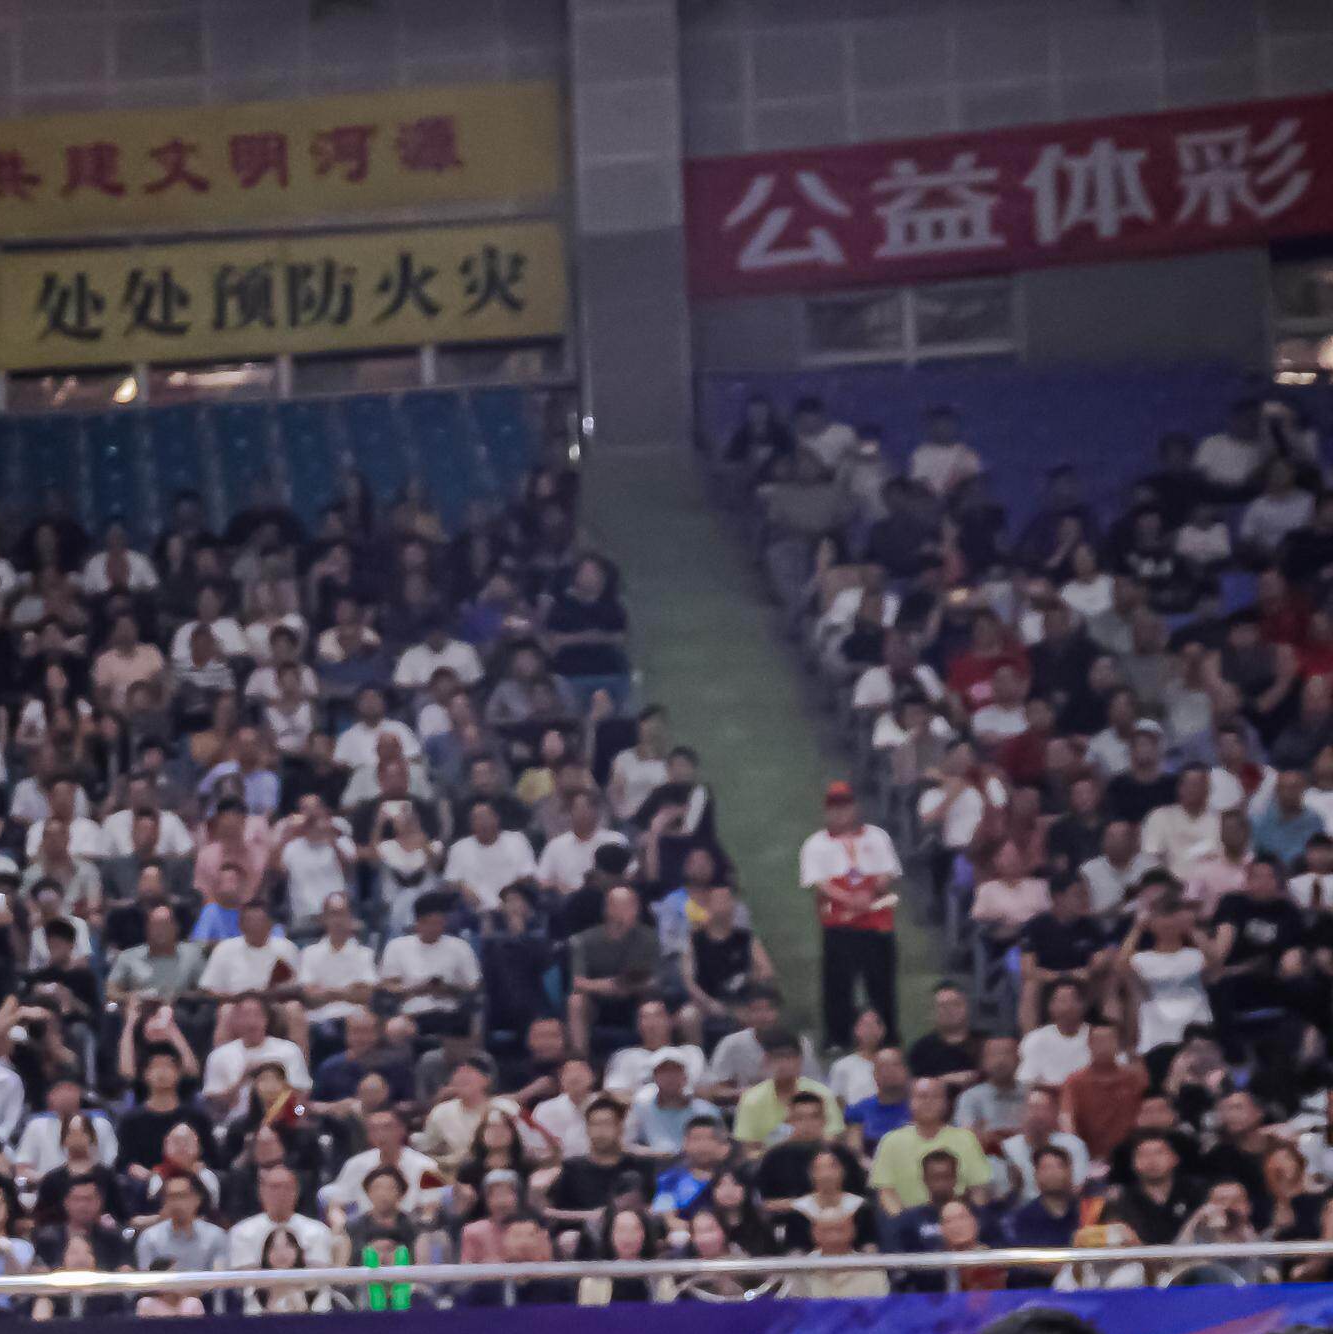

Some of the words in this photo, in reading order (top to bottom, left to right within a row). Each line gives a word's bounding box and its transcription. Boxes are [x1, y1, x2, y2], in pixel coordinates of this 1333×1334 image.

[722, 117, 1315, 272] 公益体彩
[37, 244, 529, 343] 处处预防火灾
